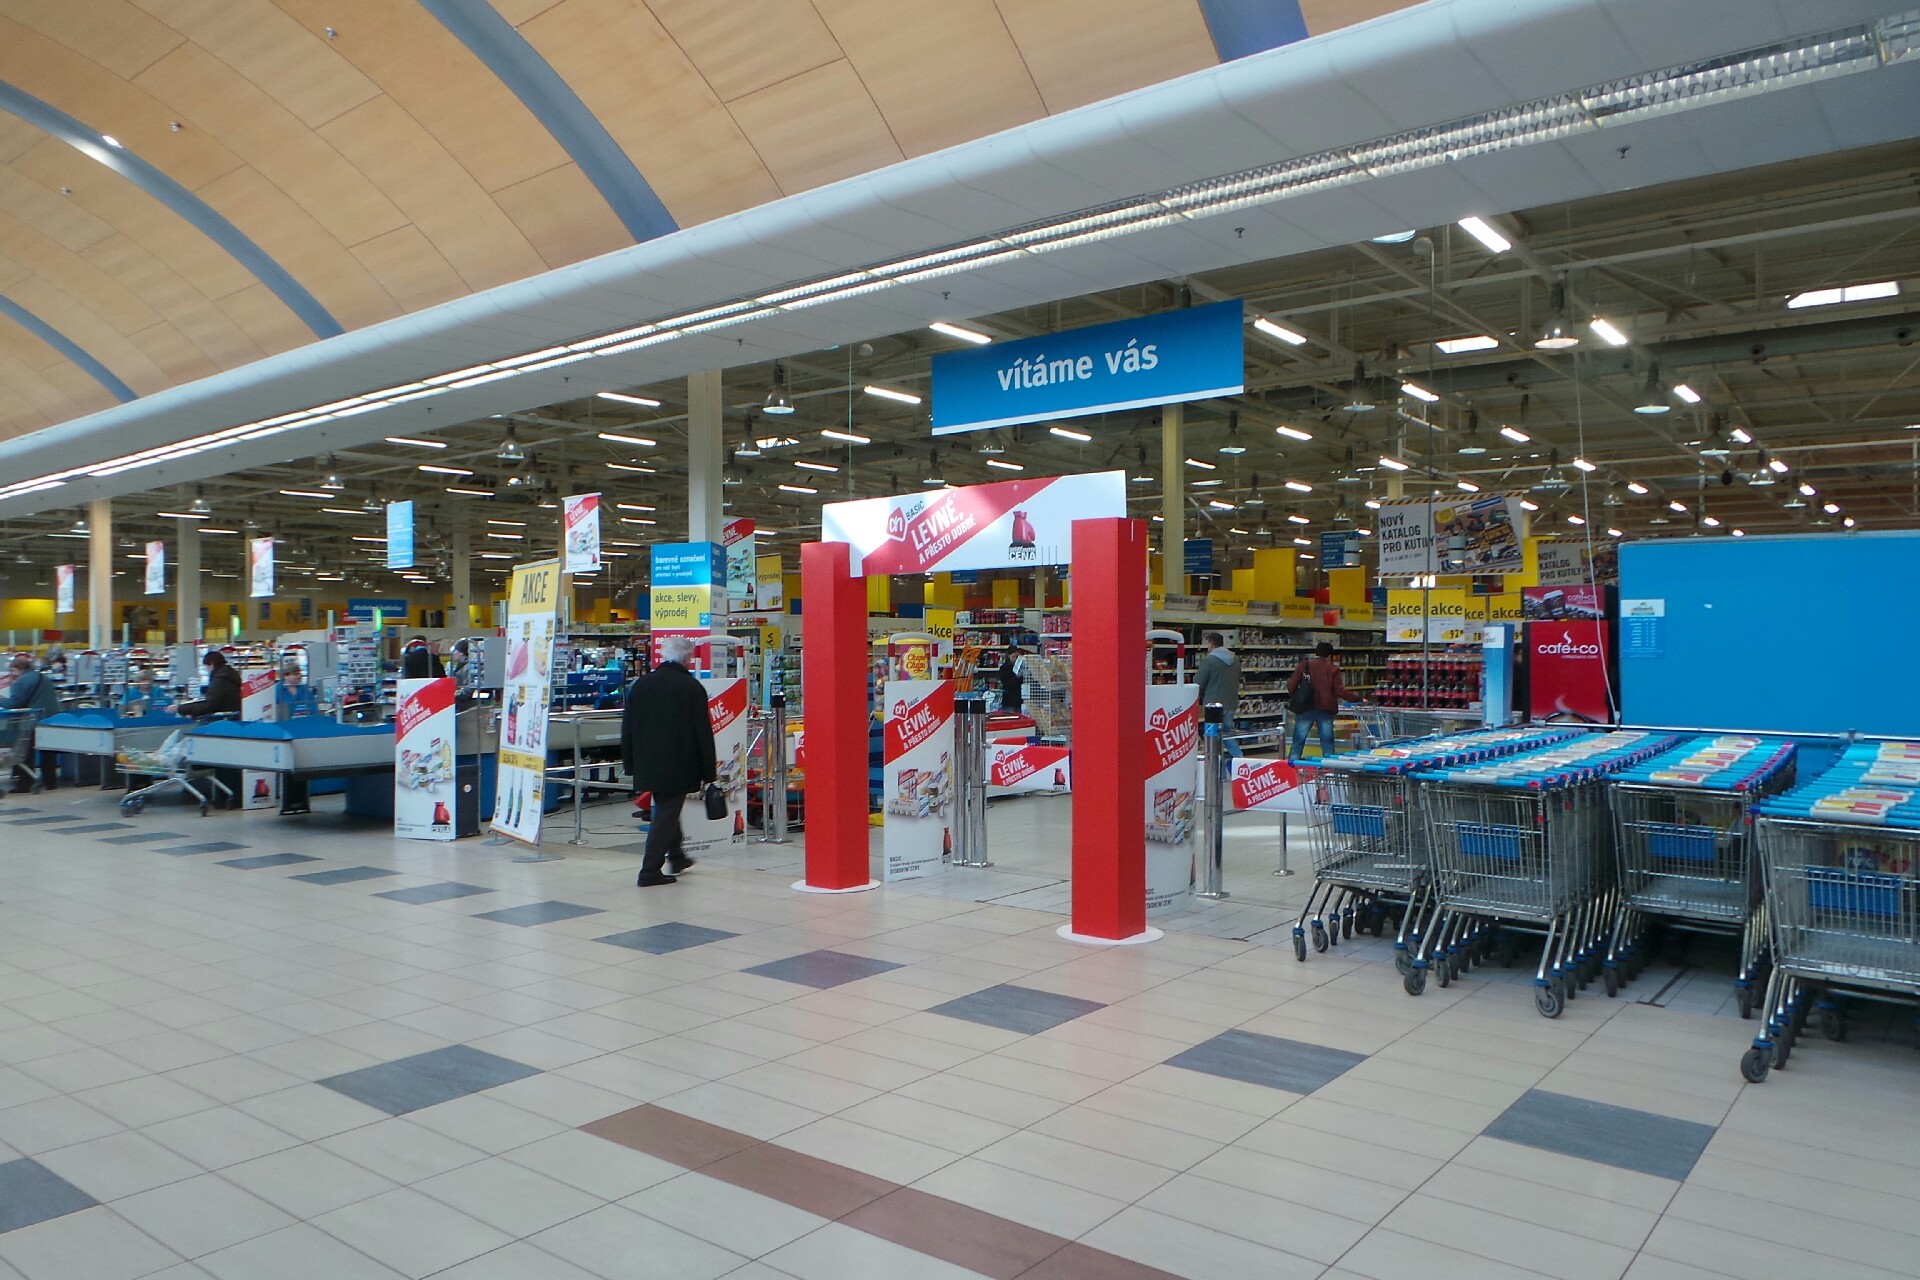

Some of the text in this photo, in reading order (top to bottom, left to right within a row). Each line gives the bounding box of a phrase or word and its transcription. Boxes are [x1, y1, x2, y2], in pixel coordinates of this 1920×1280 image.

[997, 338, 1158, 391] vítáme vás
[905, 500, 925, 520] BASIC
[910, 493, 963, 551] LEVNÉ,
[1380, 512, 1405, 528] NOVÝ
[919, 513, 977, 565] A PŘESTO DOBRÉ
[1381, 525, 1421, 541] KATALOG
[1009, 550, 1036, 560] CENA
[1383, 543, 1401, 554] PRO
[521, 570, 549, 605] AKCE
[655, 593, 699, 604] akce, slevy,
[655, 608, 688, 619] výprodej
[1390, 602, 1421, 615] akce
[1430, 602, 1463, 615] akce
[1464, 608, 1484, 620] kce
[1492, 607, 1521, 618] akce
[927, 624, 952, 638] akce
[710, 700, 729, 721] NÉ,
[1168, 705, 1183, 718] BASIC
[897, 703, 935, 740] LEVNÉ,
[1154, 713, 1196, 755] LEVNÉ,
[903, 742, 909, 751] A
[1162, 757, 1168, 767] A
[1167, 743, 1189, 763] PŘESTO
[998, 754, 1029, 779] LEVNÉ,
[1241, 768, 1281, 797] LEVNÉ,
